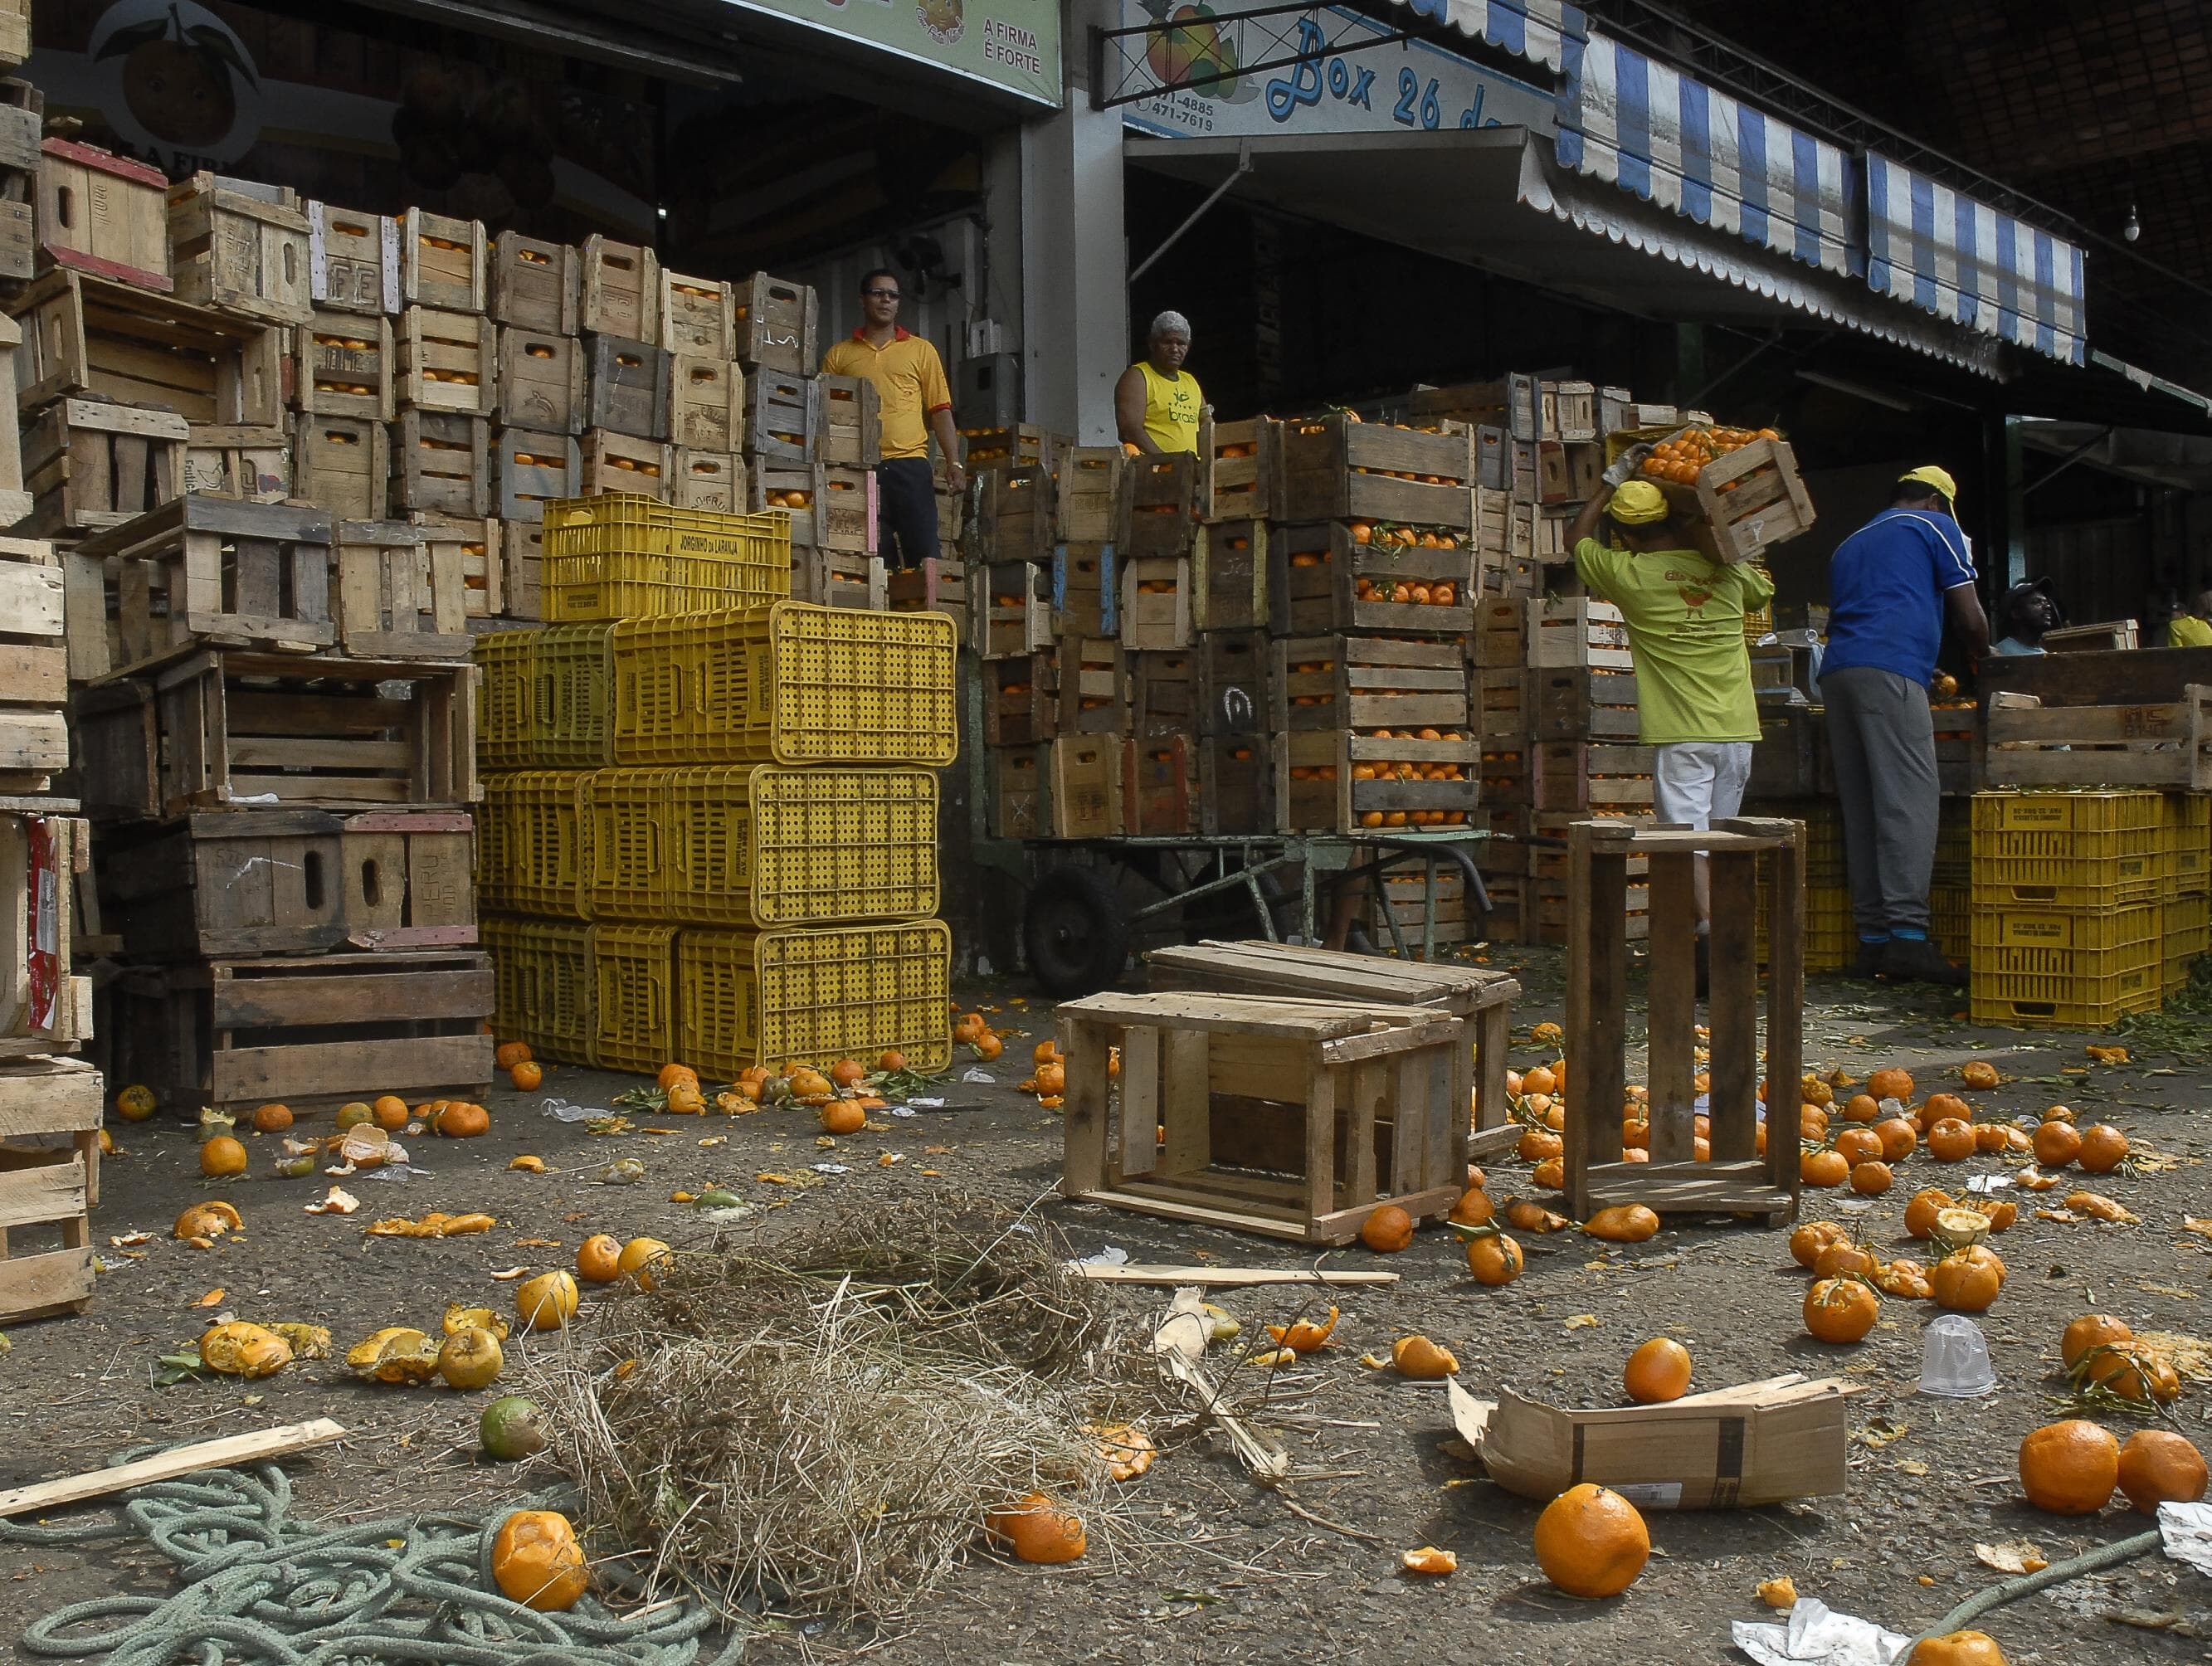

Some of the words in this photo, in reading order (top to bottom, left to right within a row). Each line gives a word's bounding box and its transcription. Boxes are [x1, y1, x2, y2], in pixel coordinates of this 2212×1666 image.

[984, 18, 994, 36] A
[996, 22, 1038, 50] FIRMA
[985, 38, 994, 59] É
[997, 46, 1041, 74] FORTE
[1265, 16, 1375, 124] Box
[1393, 66, 1440, 131] 26
[1152, 102, 1214, 132] 471-7619
[680, 534, 709, 552] JORGINHO
[709, 541, 714, 553] DA
[715, 539, 738, 555] LARANJA
